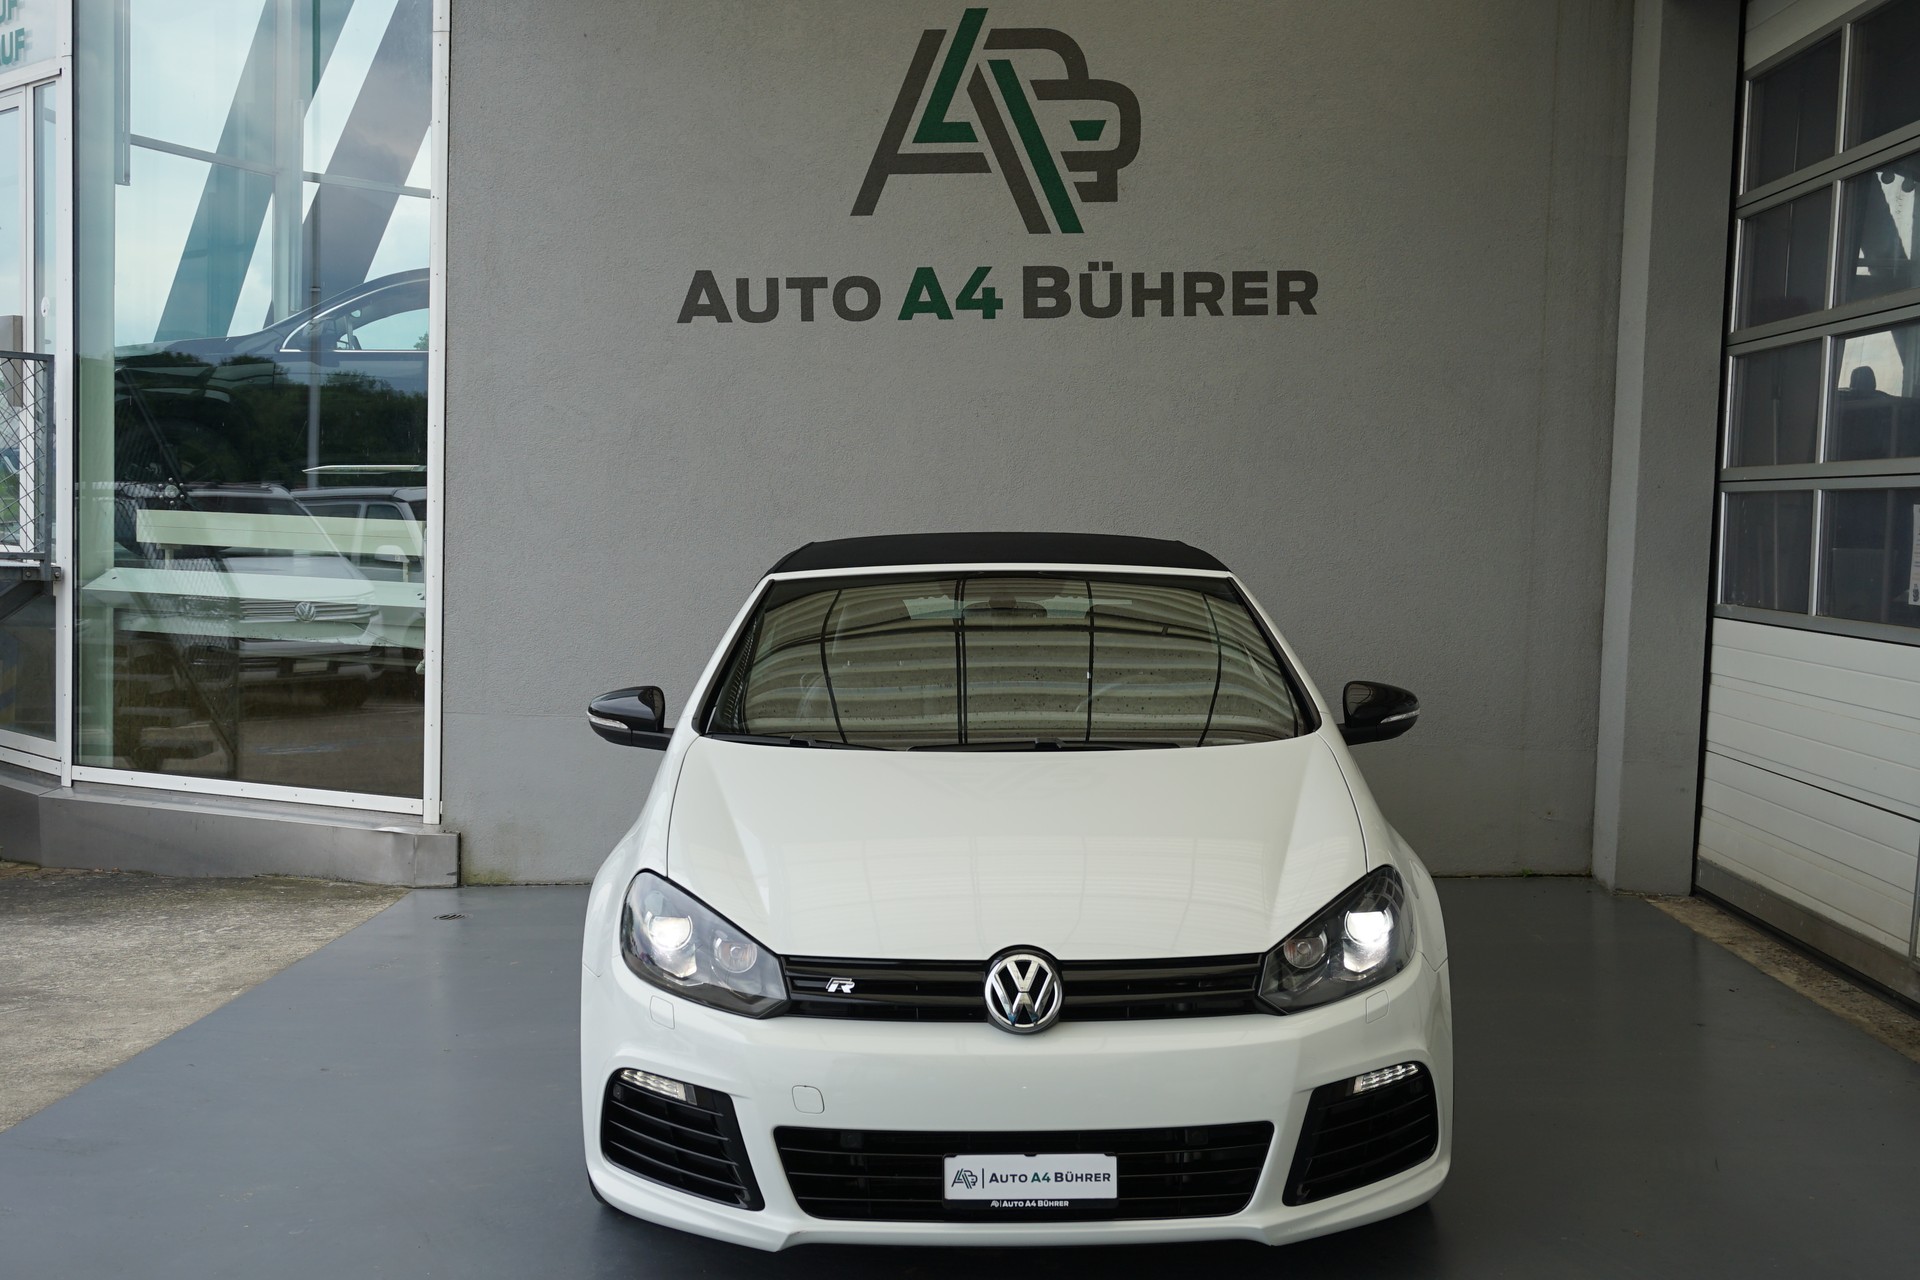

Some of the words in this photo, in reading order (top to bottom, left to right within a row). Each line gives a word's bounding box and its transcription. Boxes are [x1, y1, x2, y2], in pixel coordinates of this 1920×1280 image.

[0, 28, 25, 66] UF
[898, 266, 1003, 321] A4
[1022, 261, 1319, 319] BÜHRER
[825, 977, 855, 994] R
[985, 953, 1062, 1028] VW
[1030, 1172, 1051, 1183] A4
[1054, 1171, 1111, 1183] BÜHRER
